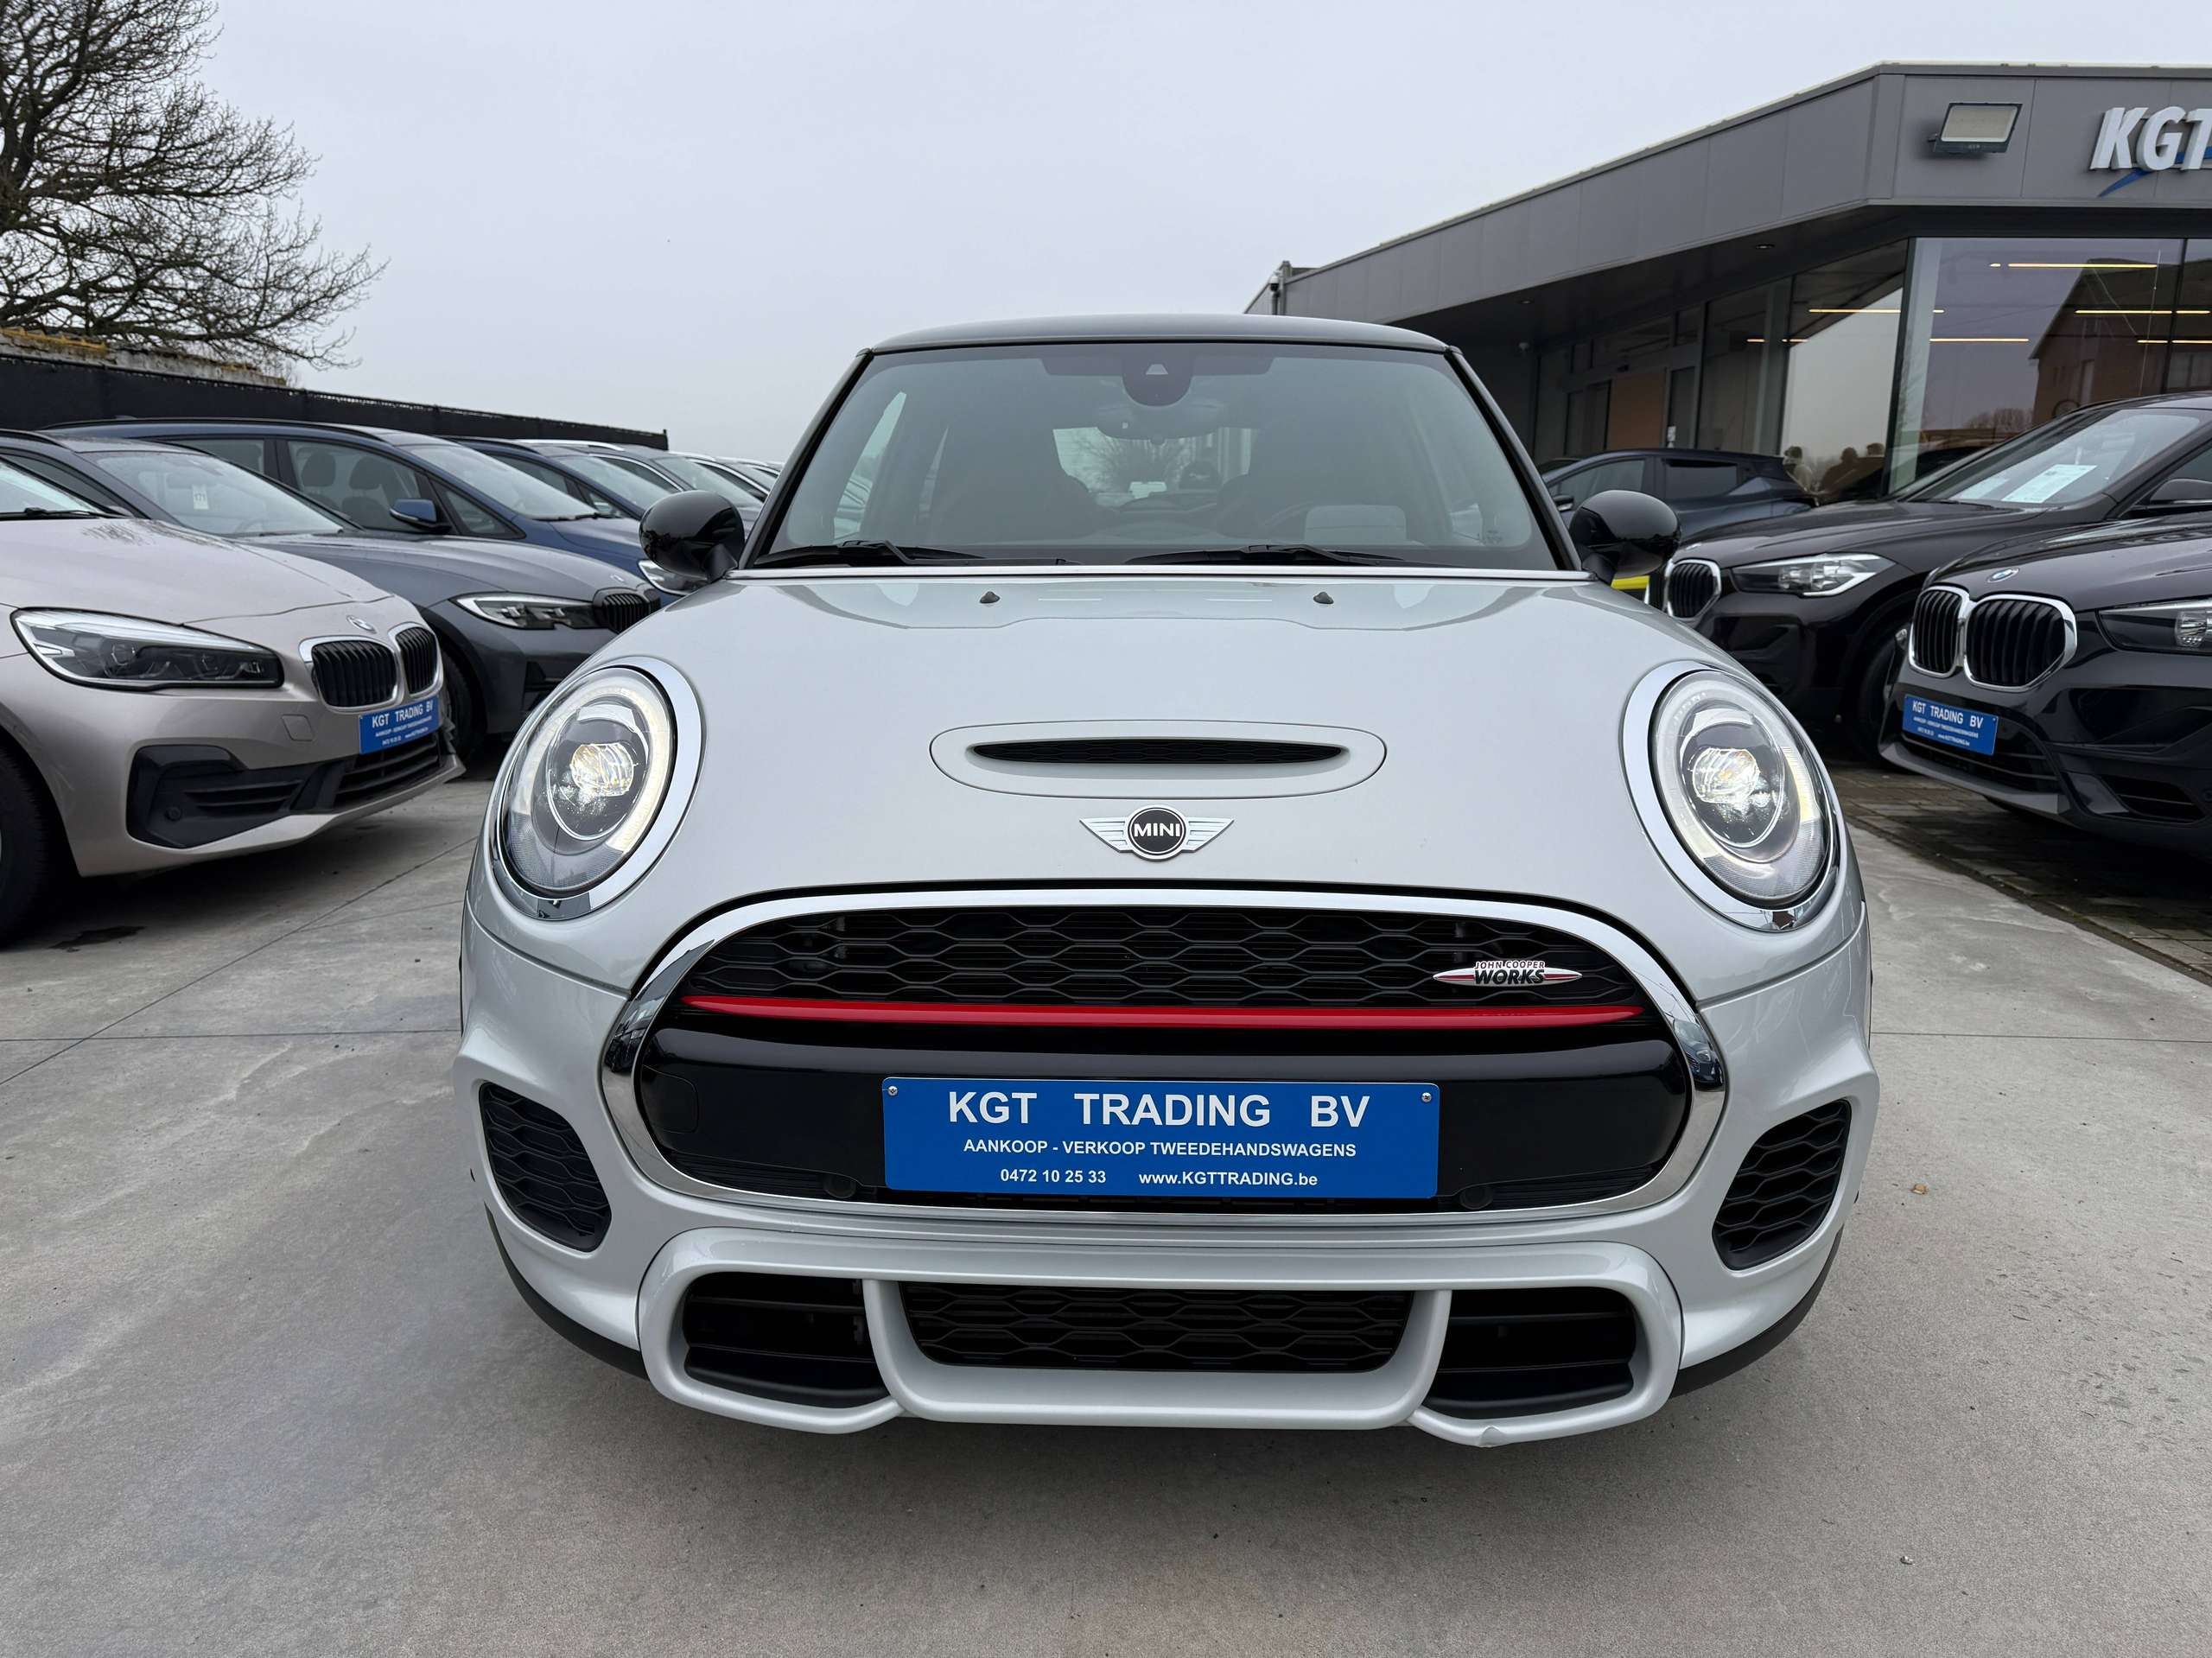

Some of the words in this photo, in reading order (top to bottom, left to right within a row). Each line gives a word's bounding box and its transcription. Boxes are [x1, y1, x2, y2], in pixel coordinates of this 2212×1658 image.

[2089, 106, 2212, 171] KGT
[372, 714, 390, 727] KGT
[395, 704, 423, 722] TRADING
[1912, 701, 1926, 715] KGT
[1930, 705, 1963, 724] TRADING
[1970, 715, 1984, 728] BV
[1134, 823, 1180, 836] MINI
[1475, 961, 1503, 969] JOHN
[1506, 960, 1545, 969] COOPER
[1475, 969, 1545, 985] WORKS
[950, 1092, 1037, 1124] KGT
[1074, 1093, 1270, 1127] TRADING
[1311, 1096, 1370, 1128] BV
[963, 1139, 1048, 1153] AANKOOP
[1062, 1140, 1146, 1155] VERKOOP
[1149, 1141, 1357, 1157] TWEEDEHANDSWAGENS
[1001, 1168, 1037, 1182] 0472
[1042, 1169, 1060, 1183] 10
[1065, 1170, 1084, 1183] 25
[1088, 1170, 1107, 1184] 33
[1138, 1171, 1318, 1186] www.KGTTRADING.be
